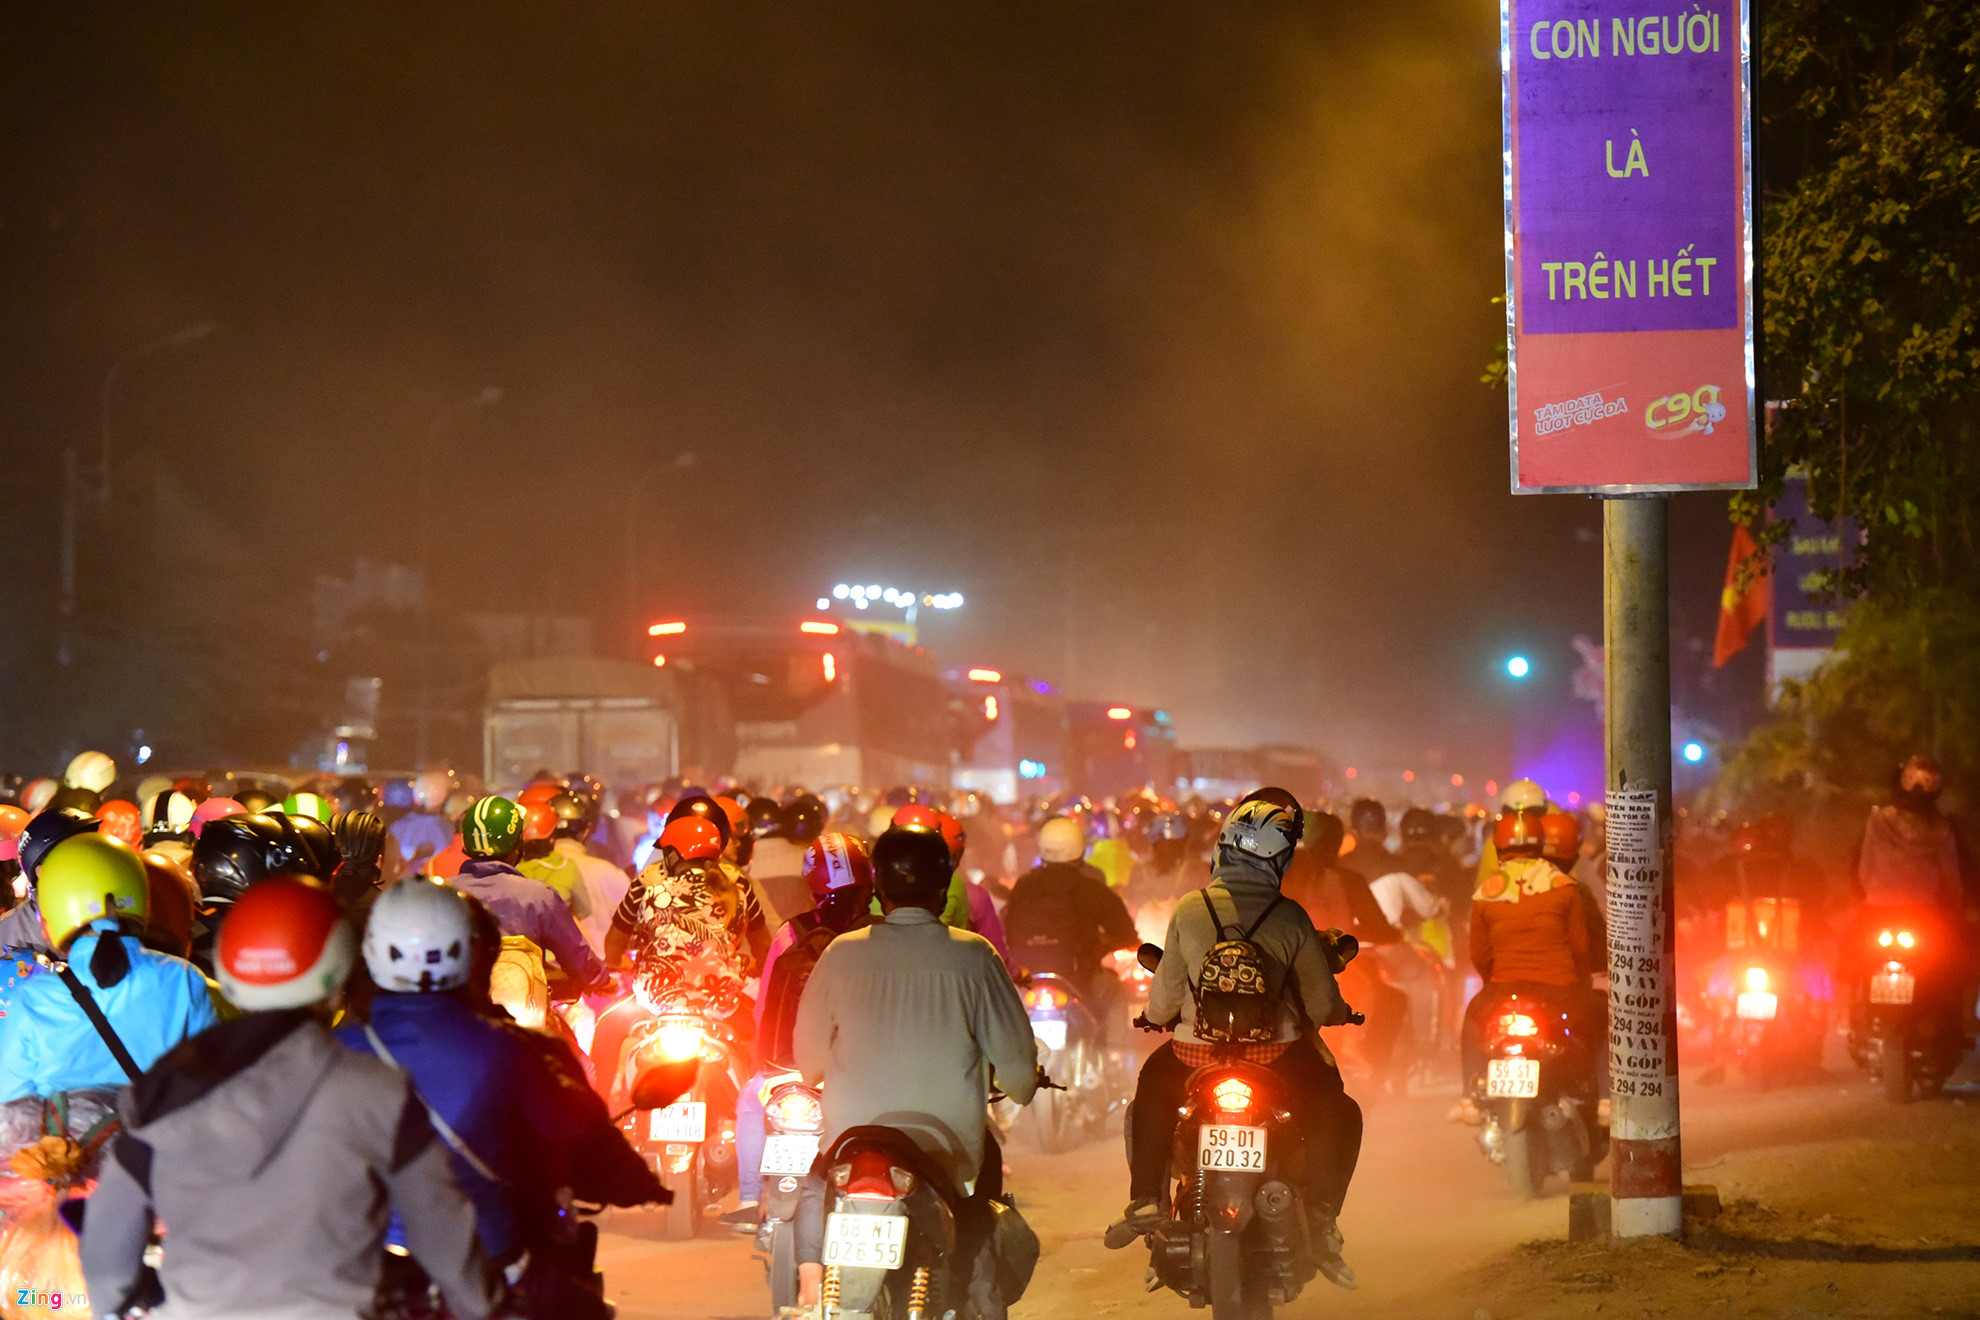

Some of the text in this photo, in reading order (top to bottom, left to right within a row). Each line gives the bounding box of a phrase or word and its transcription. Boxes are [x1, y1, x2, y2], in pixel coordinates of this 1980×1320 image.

[1530, 3, 1719, 60] CON NGƯỜI
[1605, 128, 1649, 178] LÀ
[1541, 244, 1717, 300] TRÊN HẾT
[1565, 392, 1603, 413] DATA
[507, 808, 519, 834] Grab
[1624, 866, 1660, 882] GÓP
[1613, 953, 1633, 971] 294
[1637, 957, 1660, 973] 294
[1625, 974, 1660, 990] VAY
[1624, 992, 1660, 1009] GÓP
[1613, 1014, 1660, 1036] 294 294
[1626, 1036, 1660, 1051] VAY
[1626, 1053, 1663, 1070] GÓP
[1616, 1078, 1636, 1096] 294
[1640, 1081, 1663, 1097] 294
[1209, 1129, 1255, 1148] 59-D1
[1202, 1149, 1262, 1168] 020.32
